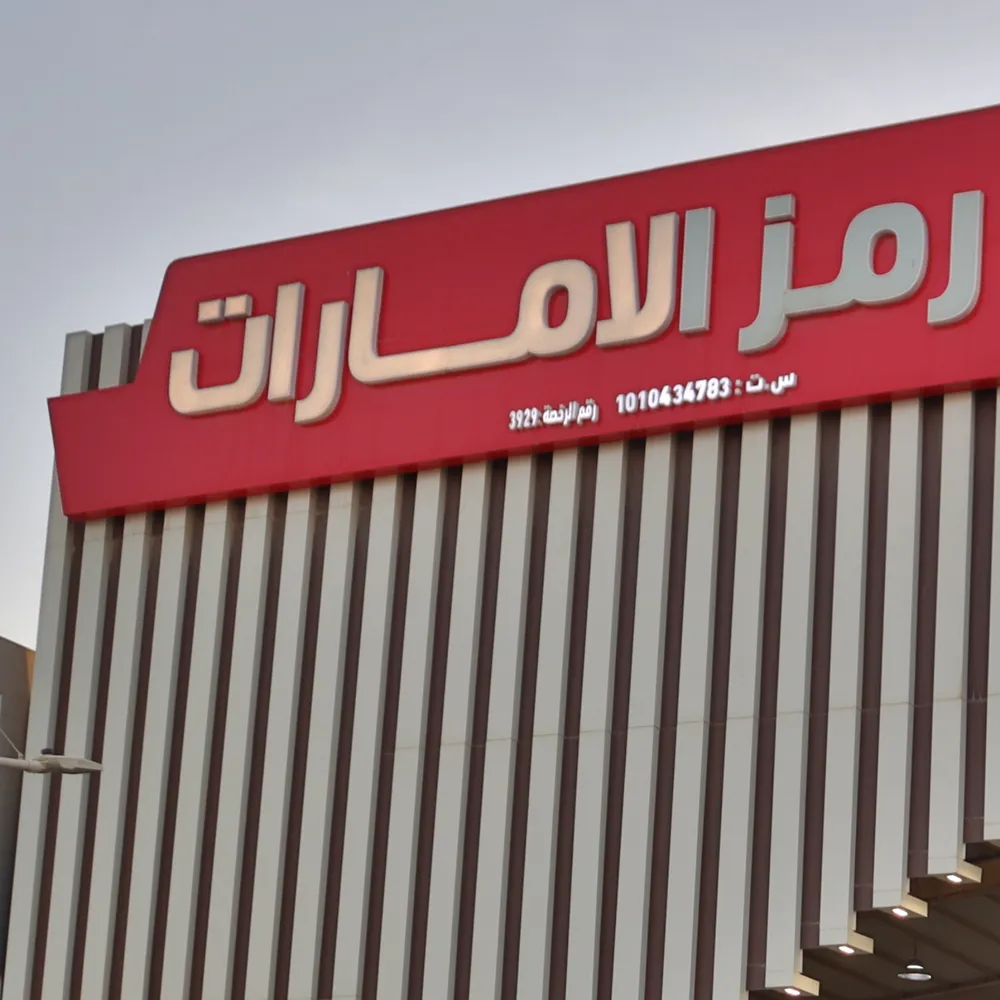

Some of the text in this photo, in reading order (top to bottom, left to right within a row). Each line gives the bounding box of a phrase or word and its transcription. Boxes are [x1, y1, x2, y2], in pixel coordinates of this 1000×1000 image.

[168, 190, 984, 424] رمز الامارات
[616, 376, 733, 414] 1010434783
